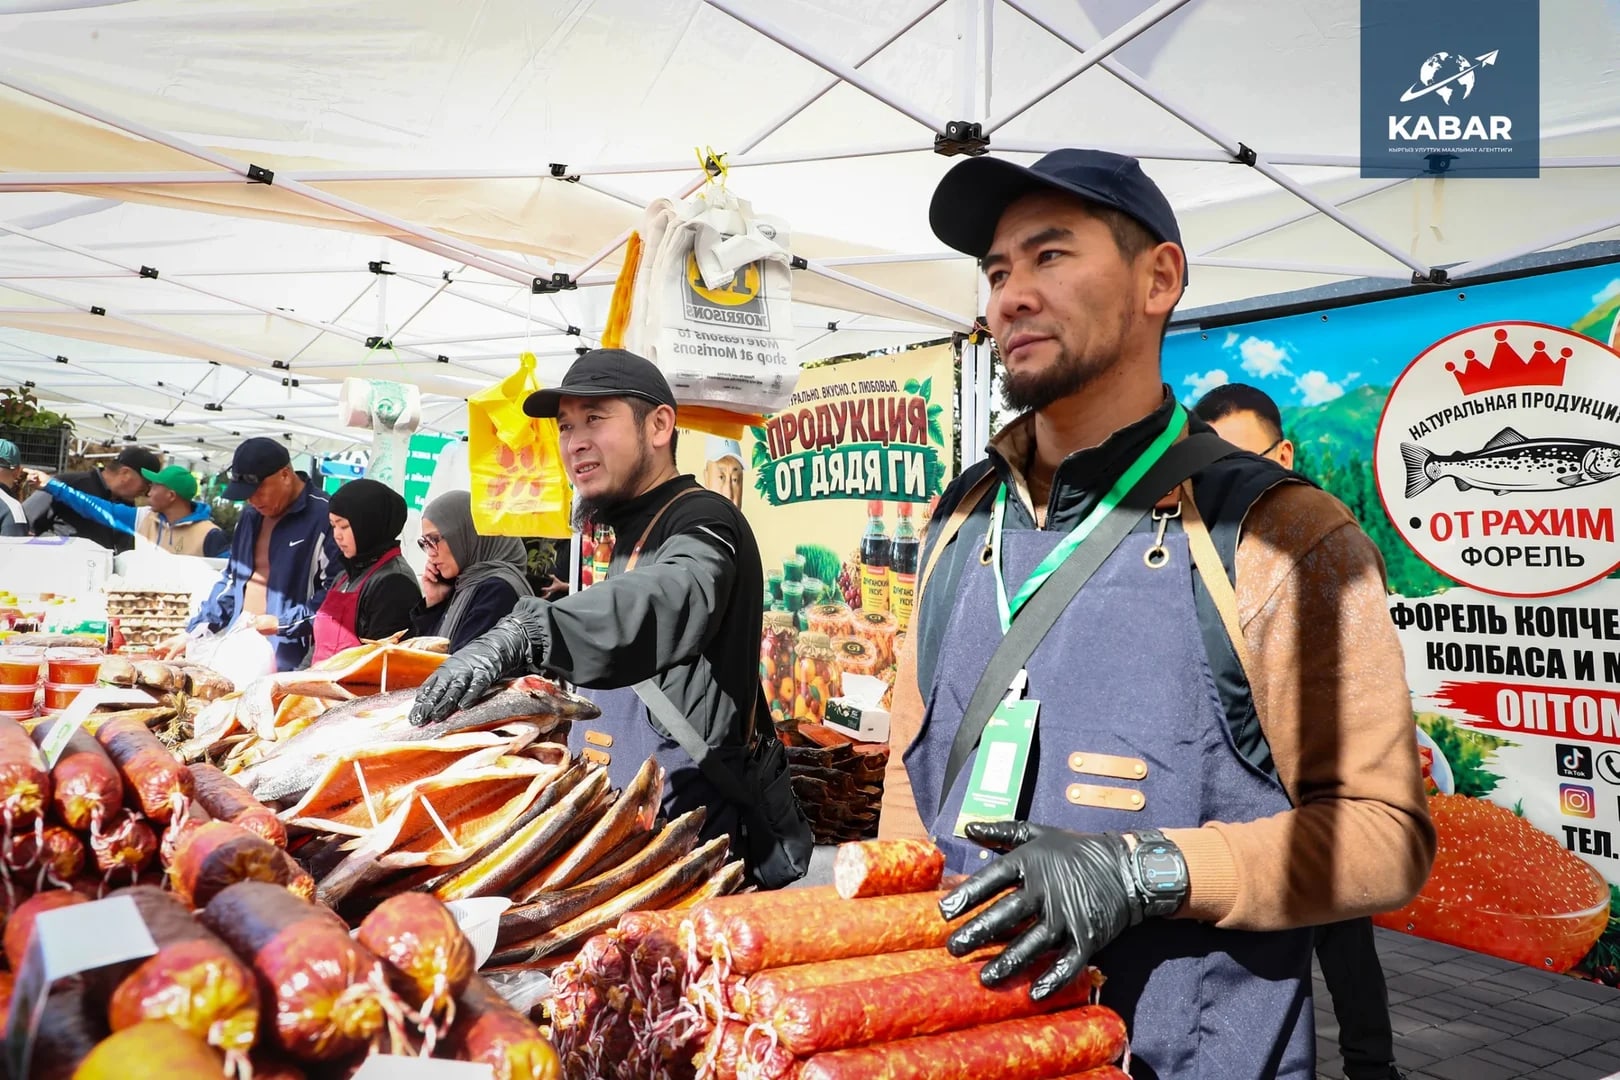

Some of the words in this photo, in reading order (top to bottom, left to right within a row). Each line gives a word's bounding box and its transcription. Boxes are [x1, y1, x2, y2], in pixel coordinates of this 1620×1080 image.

[851, 382, 857, 395] С
[766, 396, 928, 461] ПРОДУКЦИЯ
[1408, 392, 1517, 441] НАТУРАЛЬНАЯ
[774, 457, 805, 501] ОТ
[810, 450, 882, 497] ДЯДЯ
[887, 450, 926, 498] ГИ
[1429, 510, 1474, 542] ОТ
[1481, 508, 1615, 543] РАХИМ
[1461, 545, 1585, 567] ФОРЕЛЬ
[1390, 602, 1507, 635] ФОРЕЛЬ
[1426, 641, 1567, 680] КОЛБАСА
[1574, 649, 1596, 682] И
[1563, 768, 1586, 777] TikTok
[1562, 824, 1619, 860] ТЕЛ.
